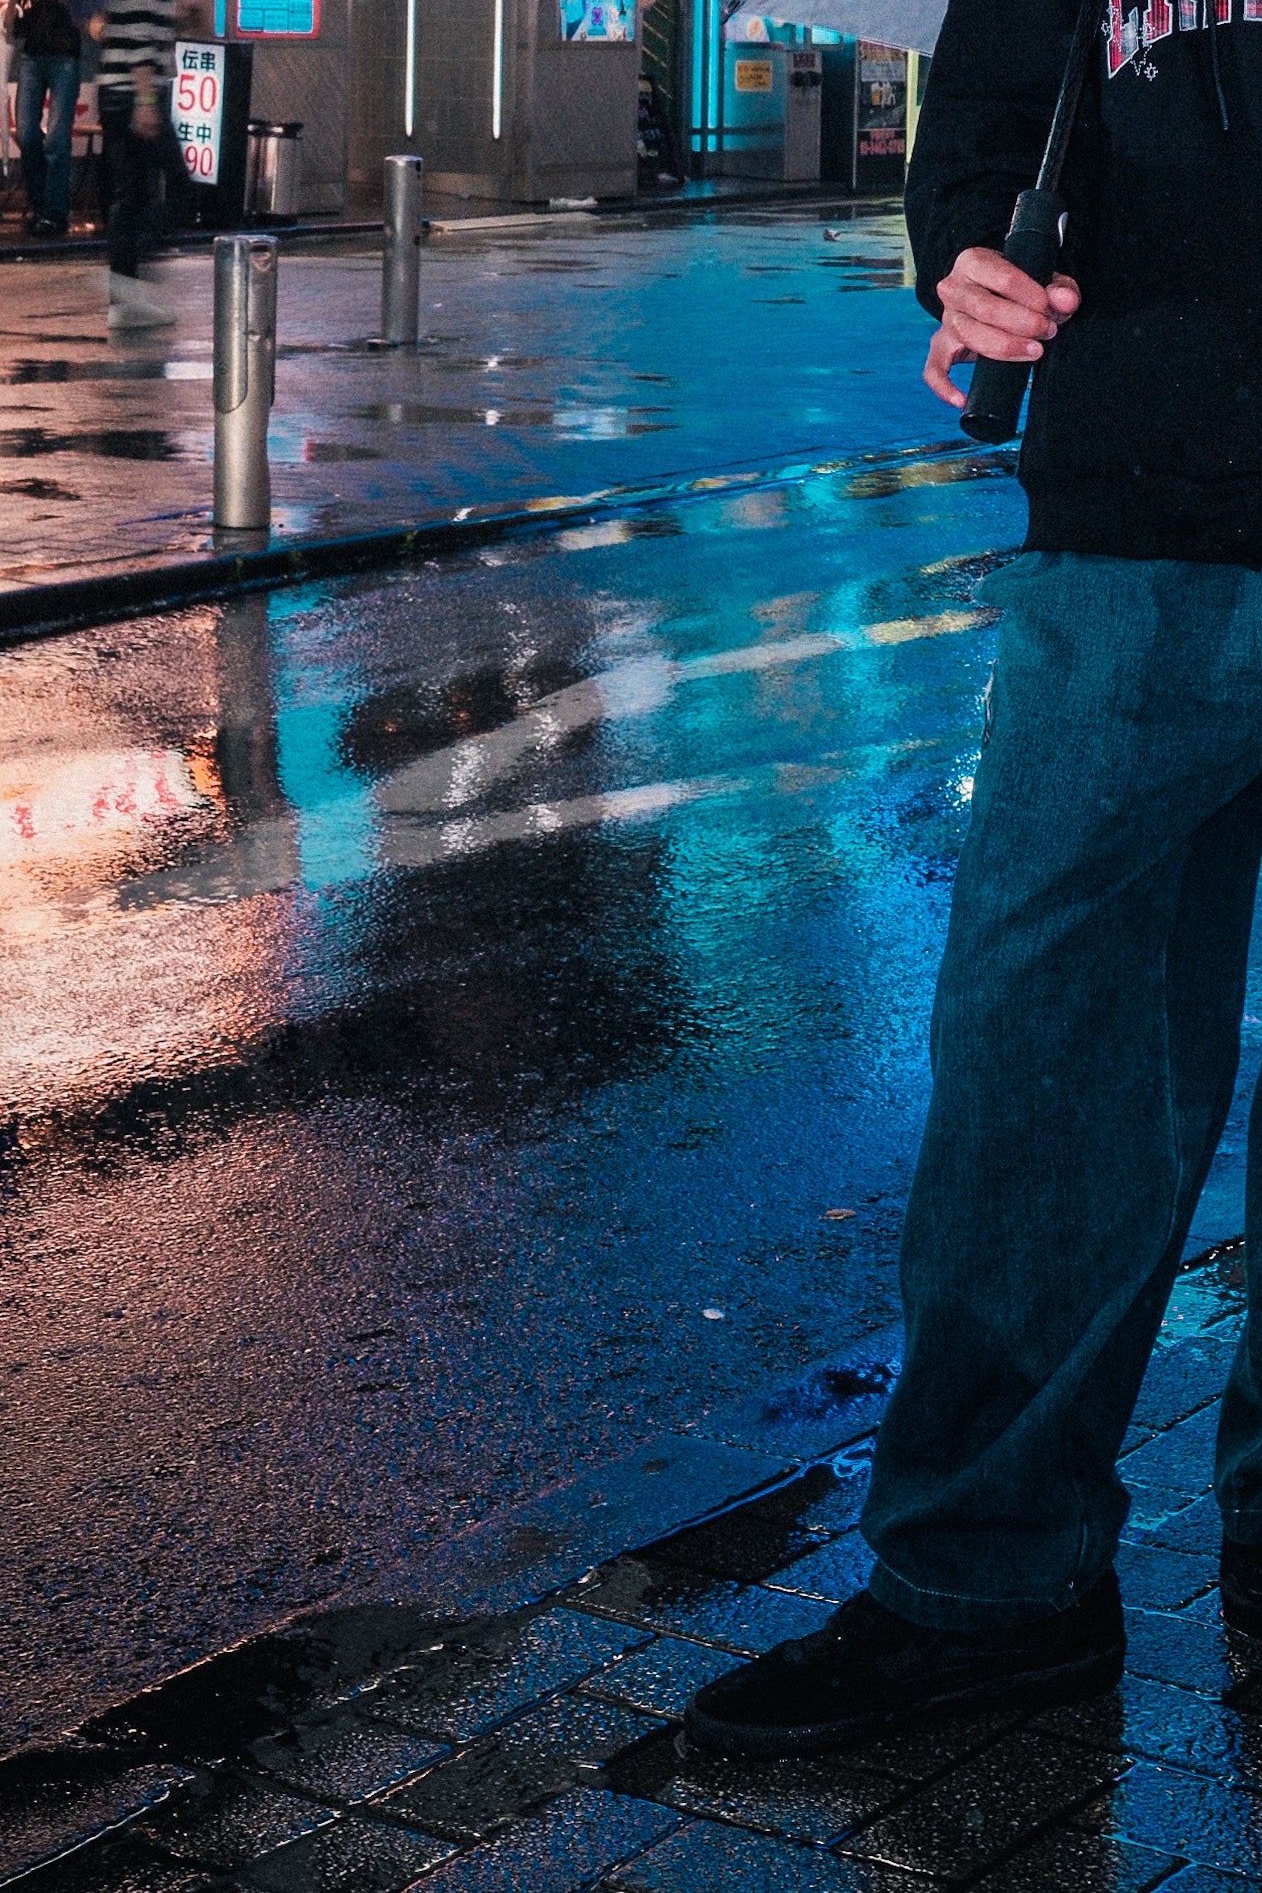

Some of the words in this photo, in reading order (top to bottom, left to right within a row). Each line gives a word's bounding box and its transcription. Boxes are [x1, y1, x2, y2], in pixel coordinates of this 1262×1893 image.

[182, 49, 216, 72] 伝串
[177, 73, 217, 113] 50
[177, 122, 212, 144] 生中
